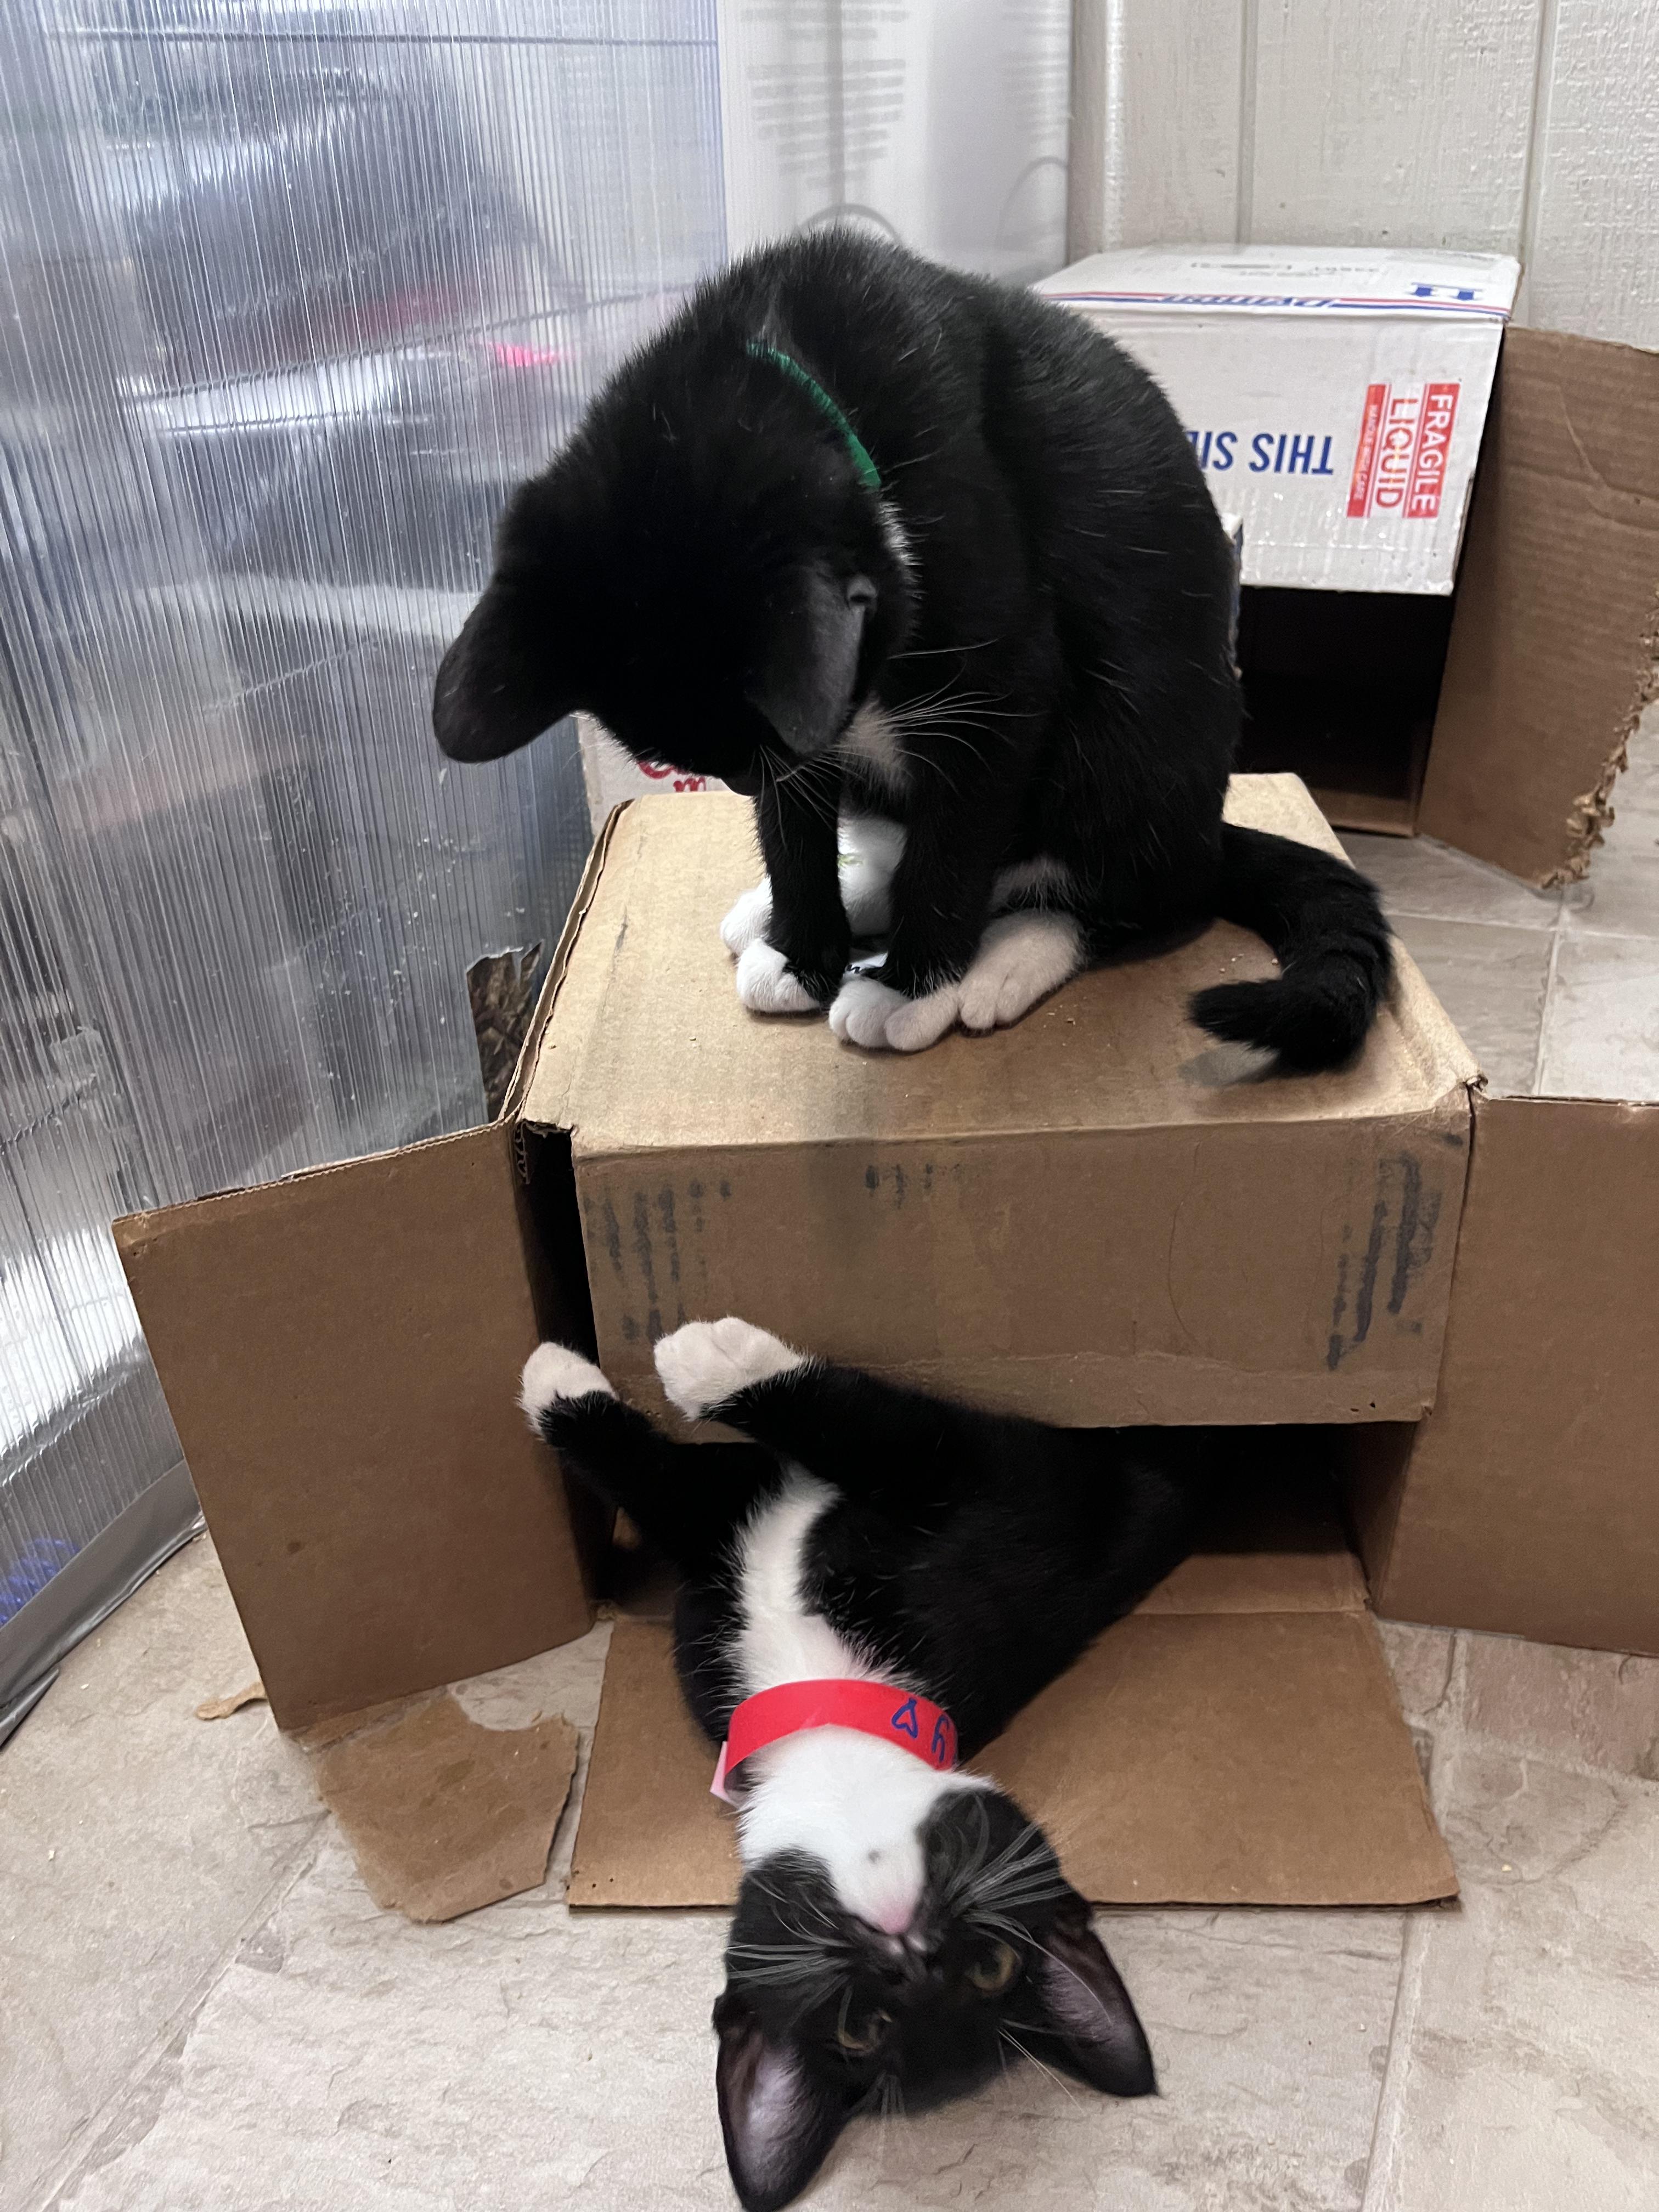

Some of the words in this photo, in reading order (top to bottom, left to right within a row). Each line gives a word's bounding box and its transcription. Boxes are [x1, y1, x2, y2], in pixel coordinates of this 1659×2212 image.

[1248, 433, 1333, 475] THIS
[1376, 398, 1418, 507] LIQUID
[1411, 394, 1453, 510] FRAGILE
